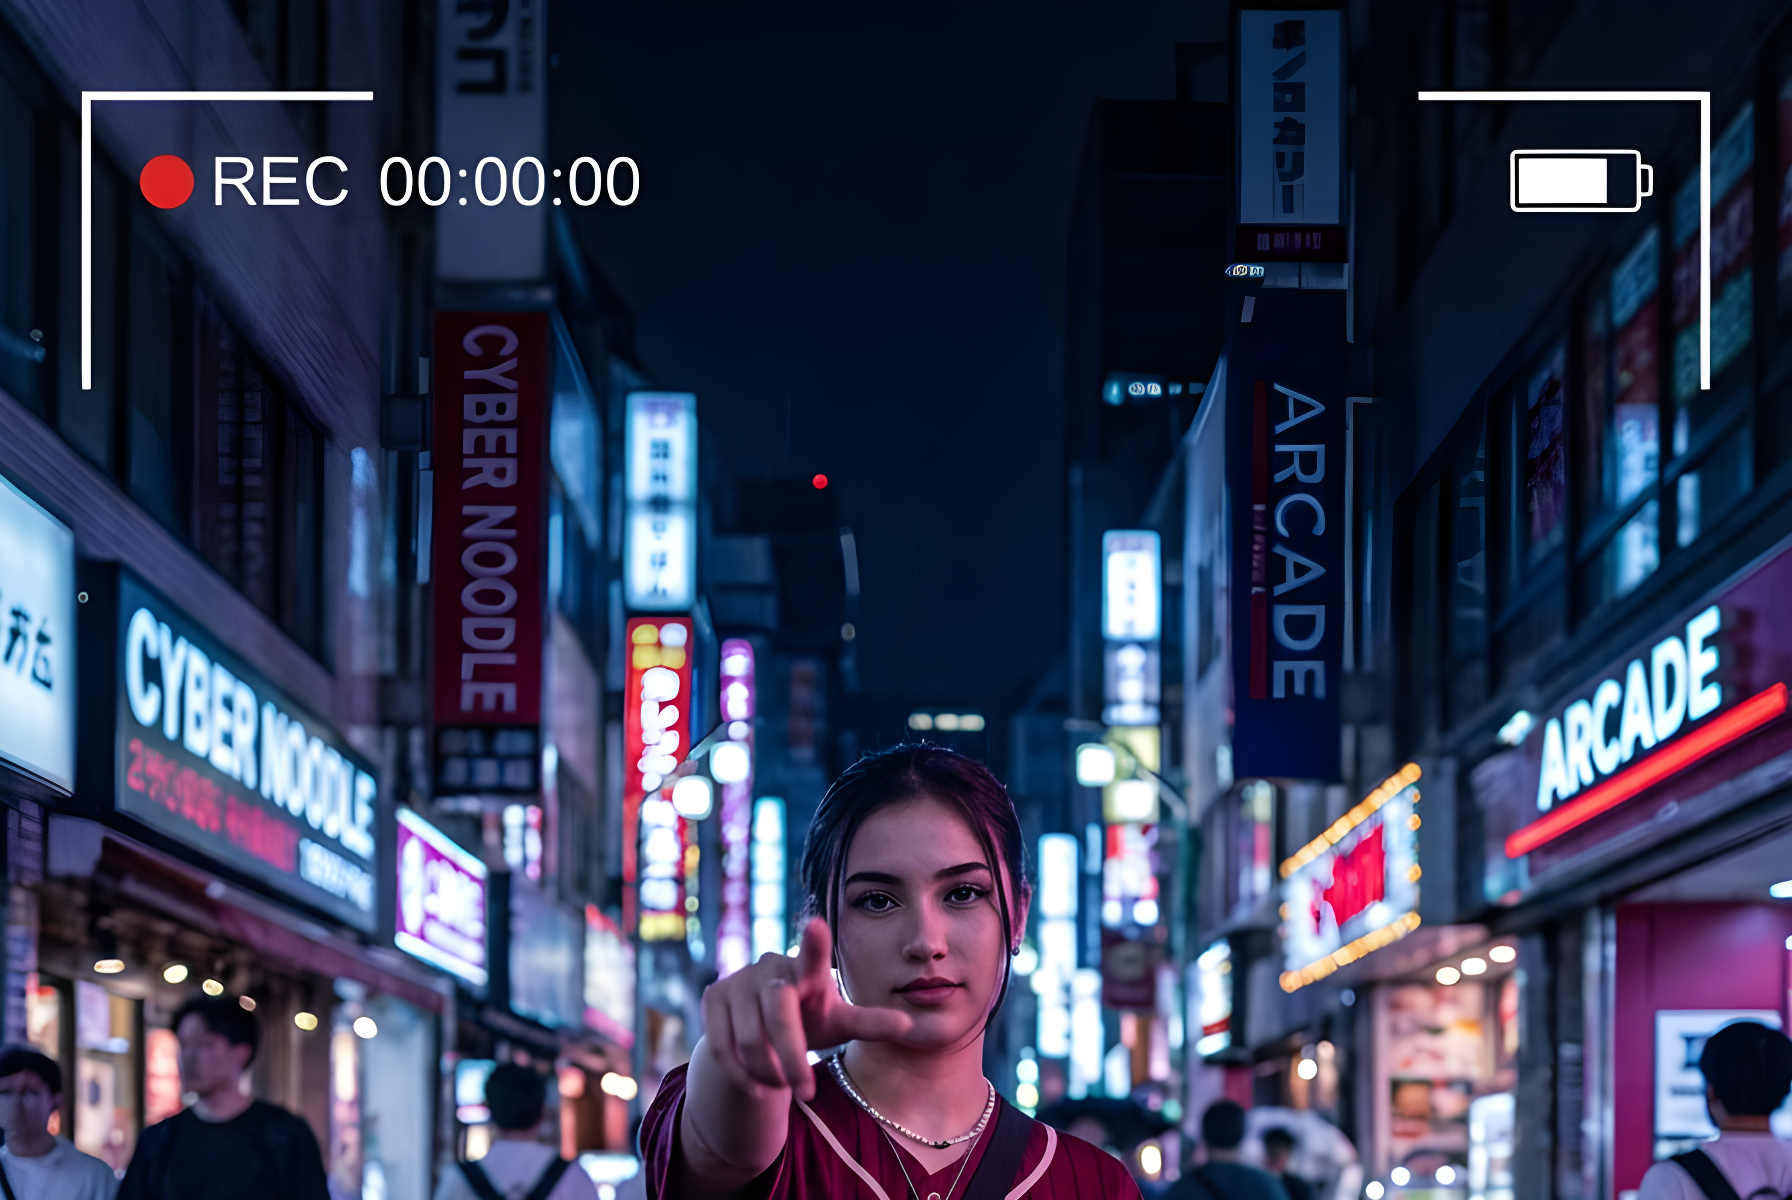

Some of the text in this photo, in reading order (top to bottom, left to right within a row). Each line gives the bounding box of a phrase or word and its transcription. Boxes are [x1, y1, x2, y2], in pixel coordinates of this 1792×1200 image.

[463, 324, 520, 489] CYBER
[461, 505, 518, 713] NOODLE
[1272, 382, 1326, 699] ARCADE
[126, 606, 259, 790] CYBER
[260, 701, 376, 858] NOODLE
[1537, 605, 1722, 811] ARCADE
